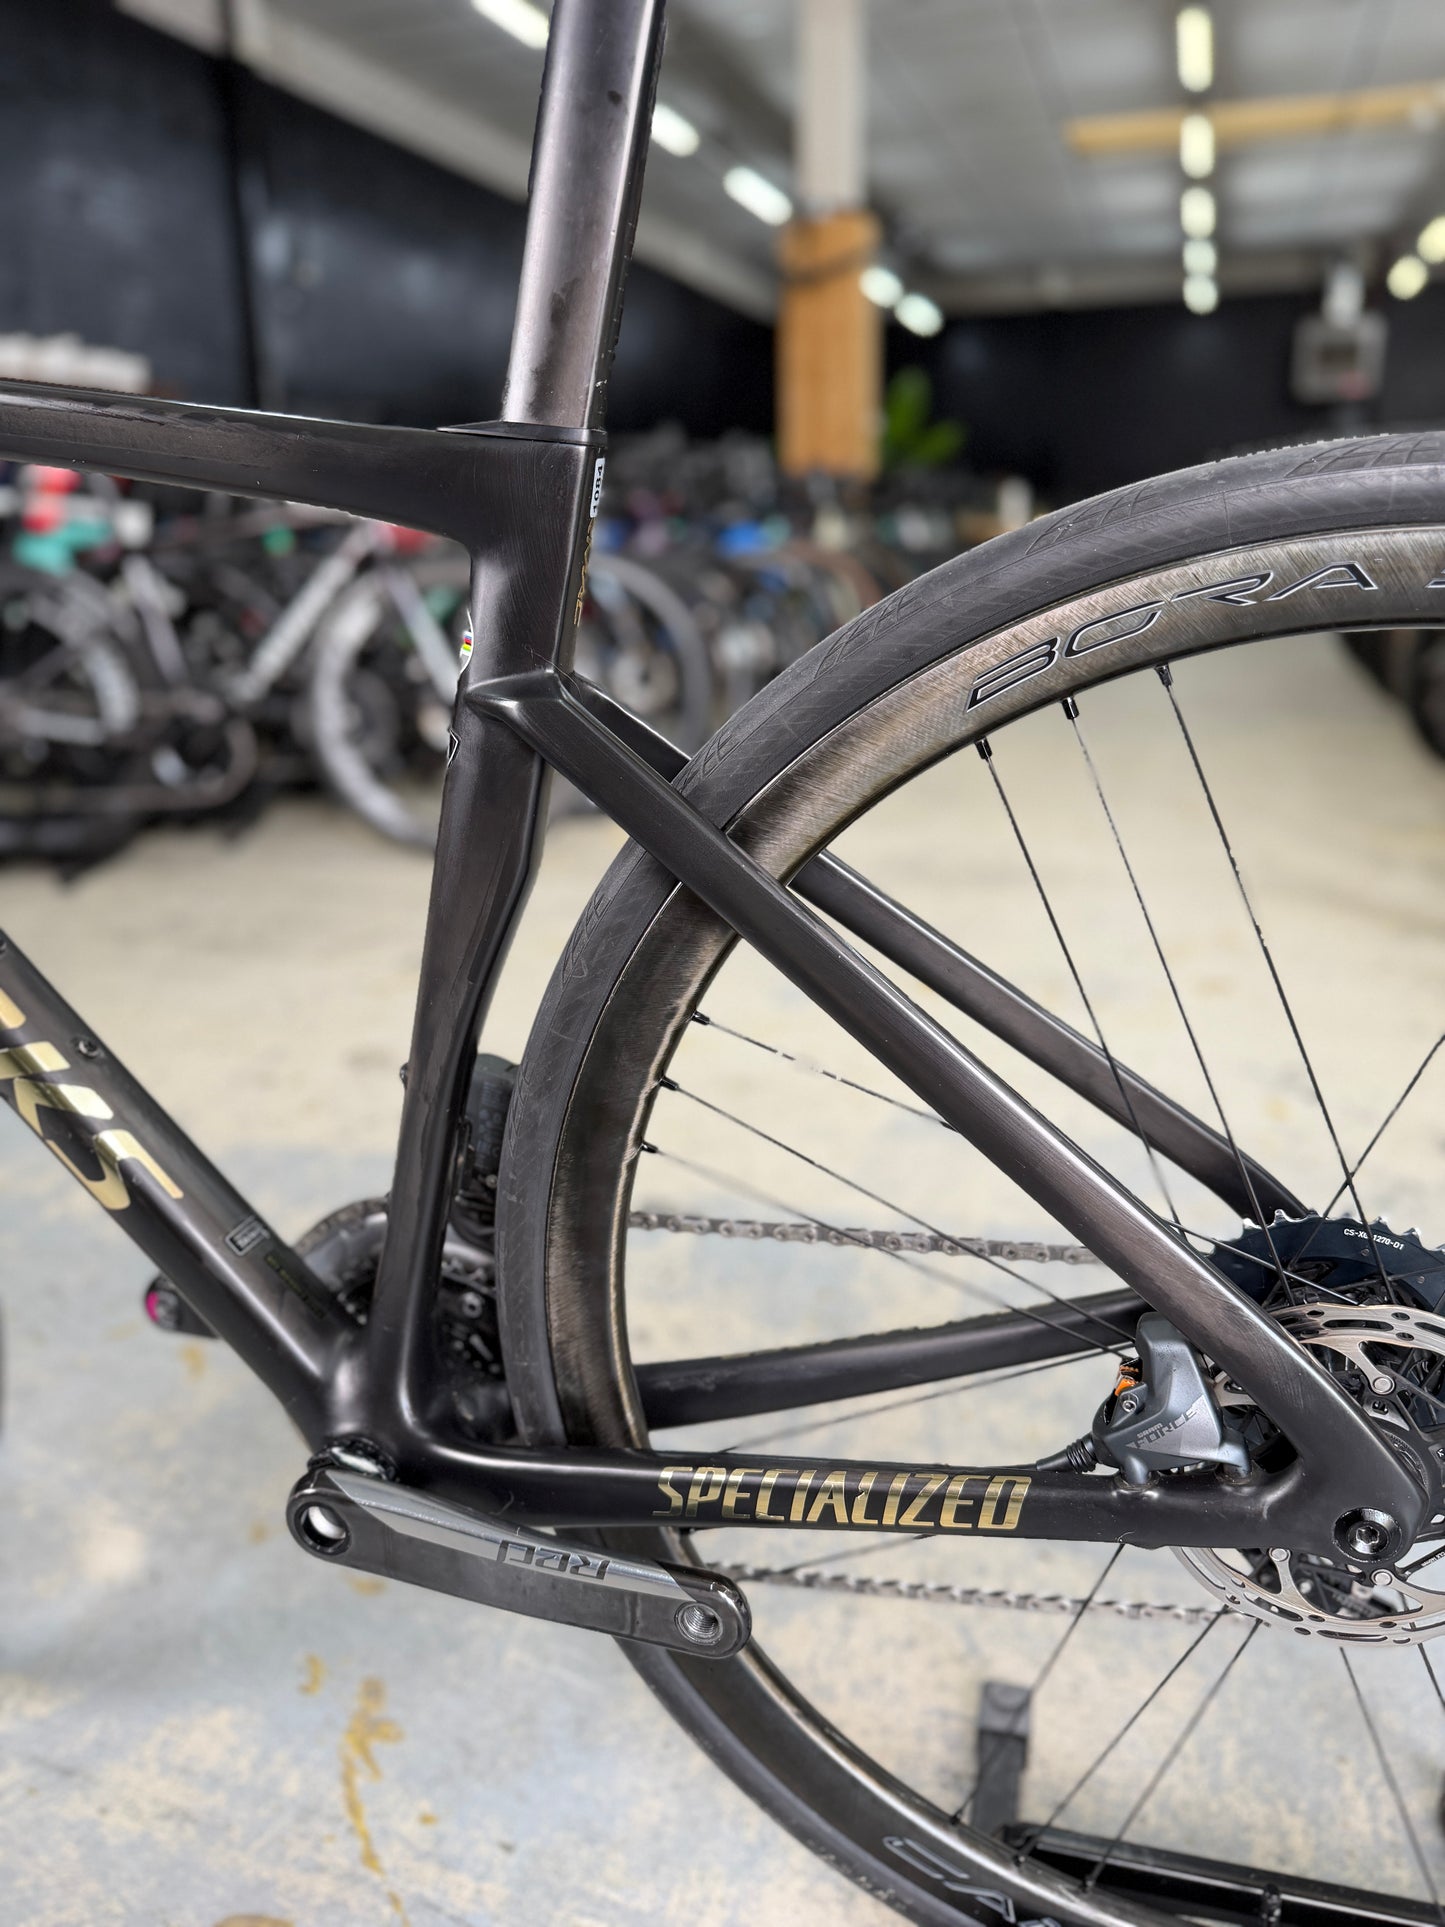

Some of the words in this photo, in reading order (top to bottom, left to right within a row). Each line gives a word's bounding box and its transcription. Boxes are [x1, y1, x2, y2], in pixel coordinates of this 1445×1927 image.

[966, 562, 1377, 712] BORA
[1134, 1408, 1198, 1448] FORCE
[652, 1466, 1032, 1529] SPECIALIZED
